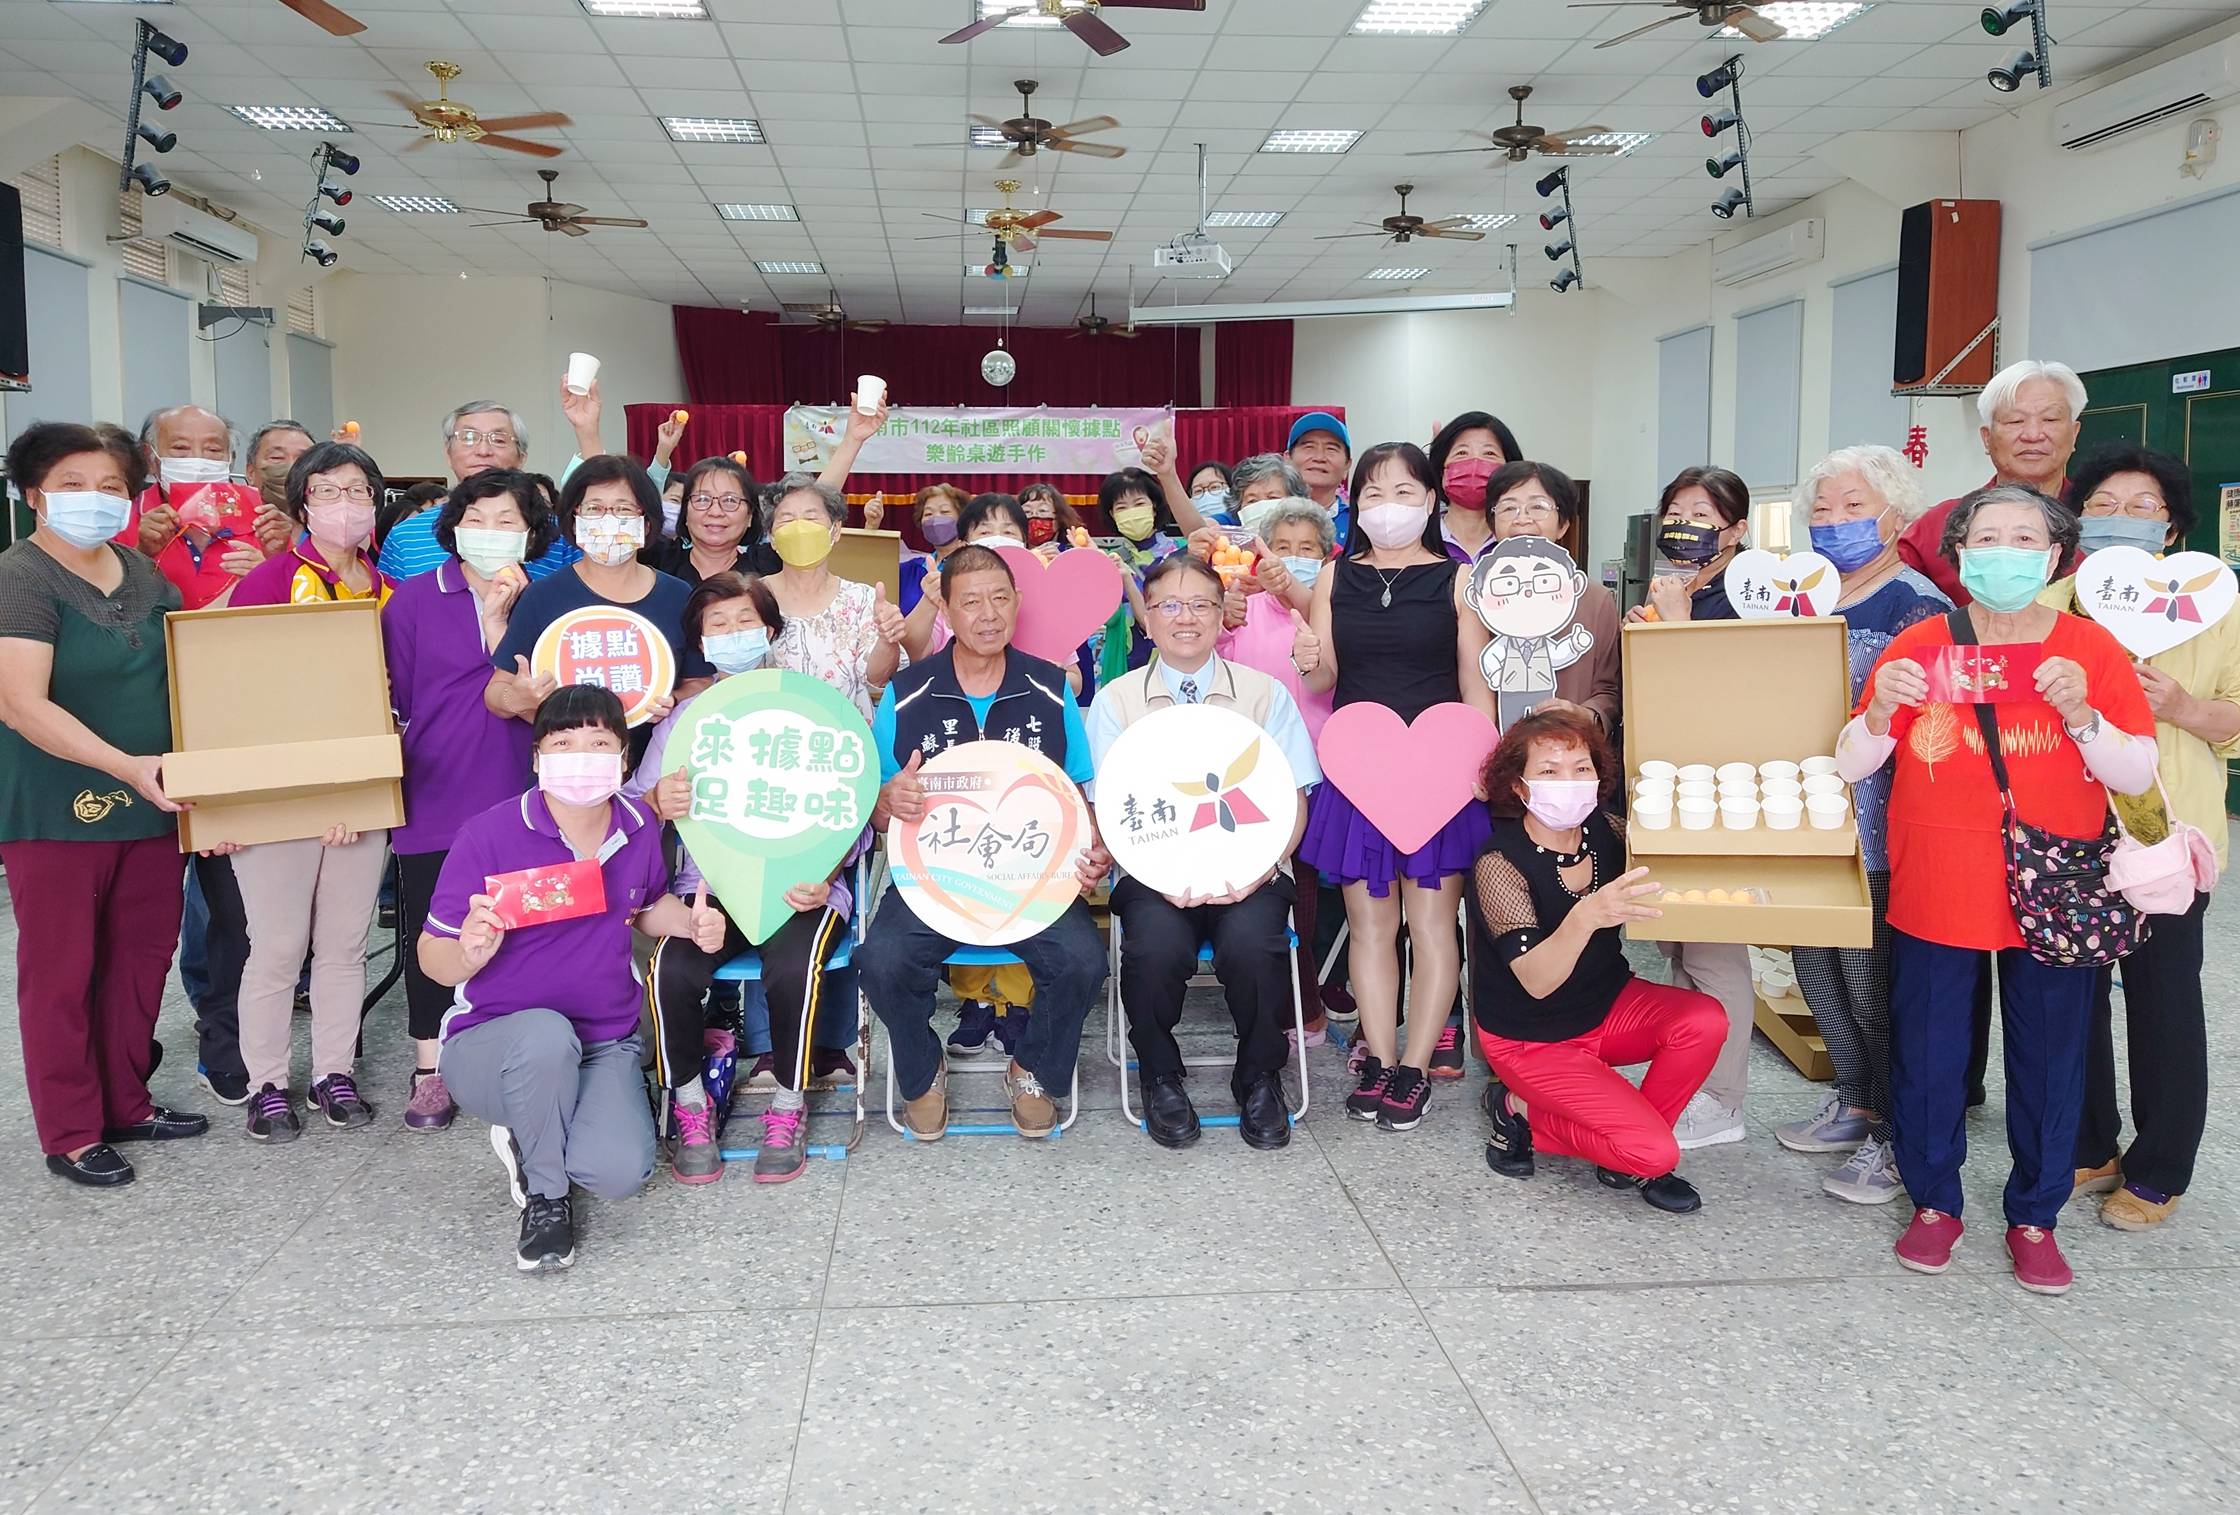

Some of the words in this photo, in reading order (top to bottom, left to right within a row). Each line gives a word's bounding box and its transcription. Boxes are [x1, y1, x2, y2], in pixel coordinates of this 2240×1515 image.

[926, 443, 1046, 463] 樂齡桌遊手作
[1902, 424, 1928, 468] 春
[1740, 577, 1770, 601] 臺南
[2096, 575, 2140, 603] 臺南
[1742, 602, 1769, 611] TAINAN
[2098, 602, 2135, 612] TAINAN
[570, 629, 639, 659] 據點
[696, 718, 860, 773] 來據點
[693, 776, 855, 827] 足趣味
[1120, 793, 1176, 832] 臺南
[918, 807, 1050, 869] 社會局
[1128, 827, 1178, 846] TAINAN
[986, 873, 1016, 881] SOCIAL
[1051, 872, 1077, 880] BURE
